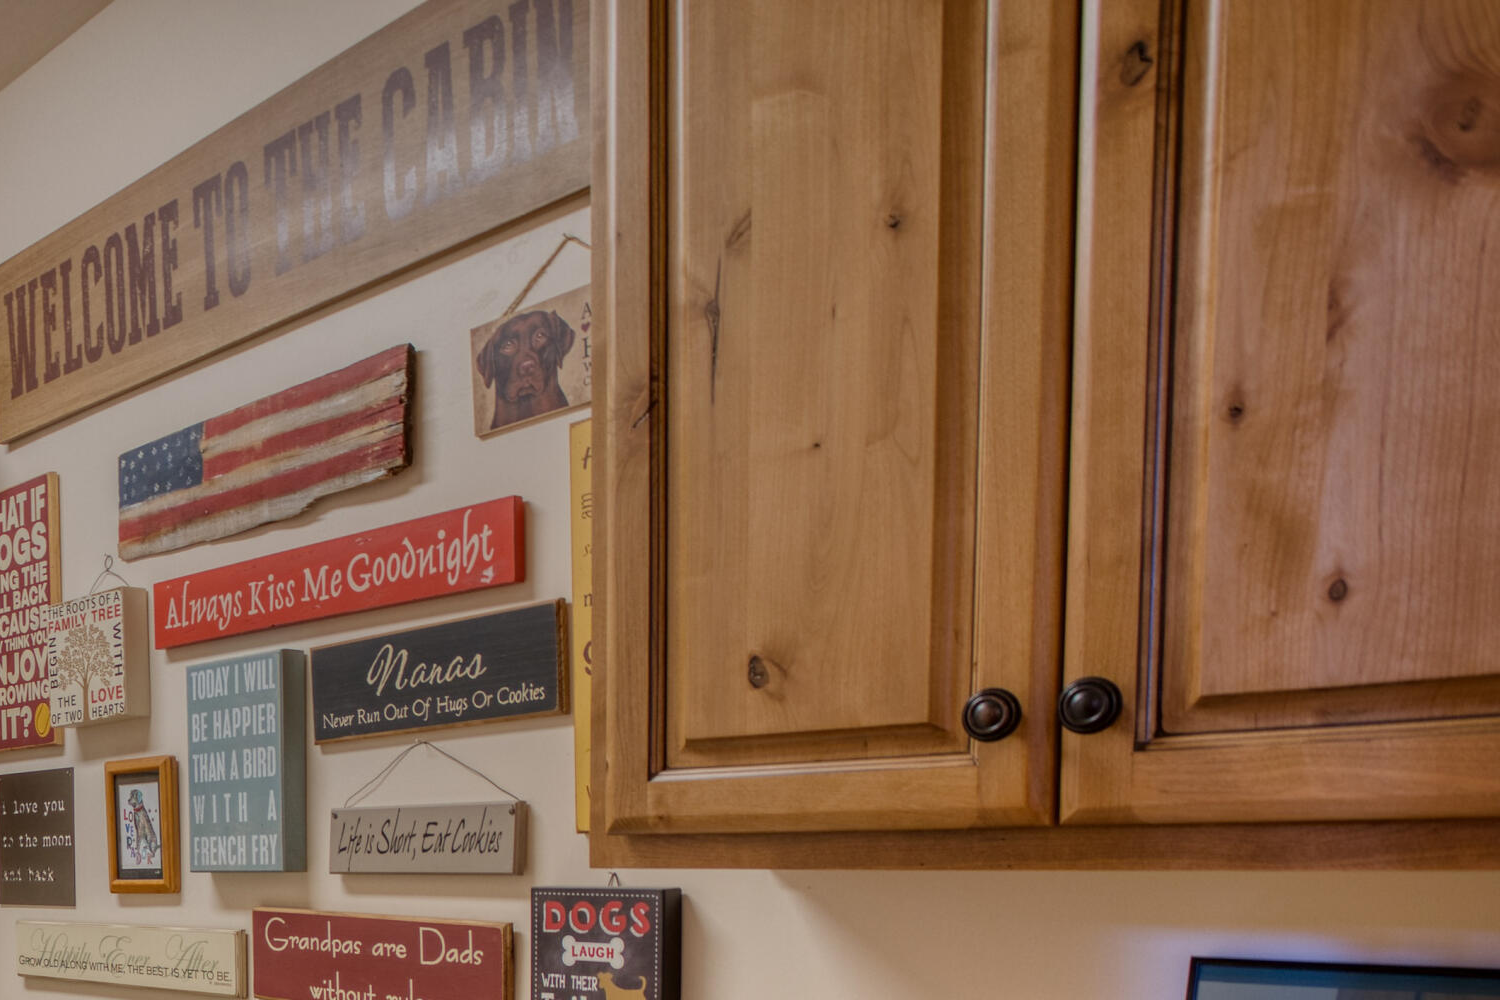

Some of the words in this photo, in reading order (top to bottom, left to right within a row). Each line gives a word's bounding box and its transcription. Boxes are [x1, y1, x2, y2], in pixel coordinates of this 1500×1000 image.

[4, 199, 183, 400] WELCOME
[192, 160, 250, 311] TO
[263, 92, 368, 277] THE
[381, 0, 580, 224] CABIN
[30, 484, 46, 522] IF
[21, 561, 48, 584] THE
[165, 581, 243, 631] Always
[249, 574, 295, 616] Kiss
[301, 565, 342, 601] Me
[346, 509, 495, 594] Goodnight
[13, 582, 48, 607] BACK
[48, 607, 64, 620] THE
[66, 596, 96, 615] ROOTS
[99, 593, 110, 604] OF
[111, 591, 120, 602] A
[48, 616, 89, 634] FAMILY
[91, 604, 121, 620] TREE
[4, 635, 30, 652] THINK
[32, 628, 50, 646] YOU
[112, 622, 123, 677] WITH
[50, 637, 58, 689] BEGIN
[191, 666, 229, 700] TODAY
[234, 665, 239, 694] I
[244, 658, 275, 693] WILL
[367, 644, 487, 696] Nanas
[58, 696, 76, 709] THE
[91, 685, 124, 704] LOVE
[92, 702, 124, 718] HEARTS
[323, 713, 354, 729] Never
[357, 709, 380, 724] Run
[384, 704, 408, 722] Out
[412, 698, 431, 720] Of
[437, 697, 468, 717] Hugs
[472, 690, 493, 709] Or
[497, 682, 545, 705] Cookies
[1, 706, 32, 741] IT?
[51, 711, 63, 724] OF
[66, 709, 82, 722] TWO
[192, 712, 208, 742] BE
[213, 703, 276, 740] HAPPIER
[192, 751, 225, 783] THAN
[230, 749, 239, 780] A
[243, 746, 276, 779] BIRD
[193, 792, 248, 824] WITH
[268, 790, 277, 821] A
[194, 836, 246, 866] FRENCH
[252, 834, 277, 865] FRY
[543, 901, 650, 937] DOGS
[265, 917, 362, 958] Grandpas
[372, 943, 407, 958] are
[419, 927, 484, 965] Dads
[572, 946, 614, 959] LAUGH
[542, 973, 565, 988] WITH
[571, 975, 598, 991] THEIR
